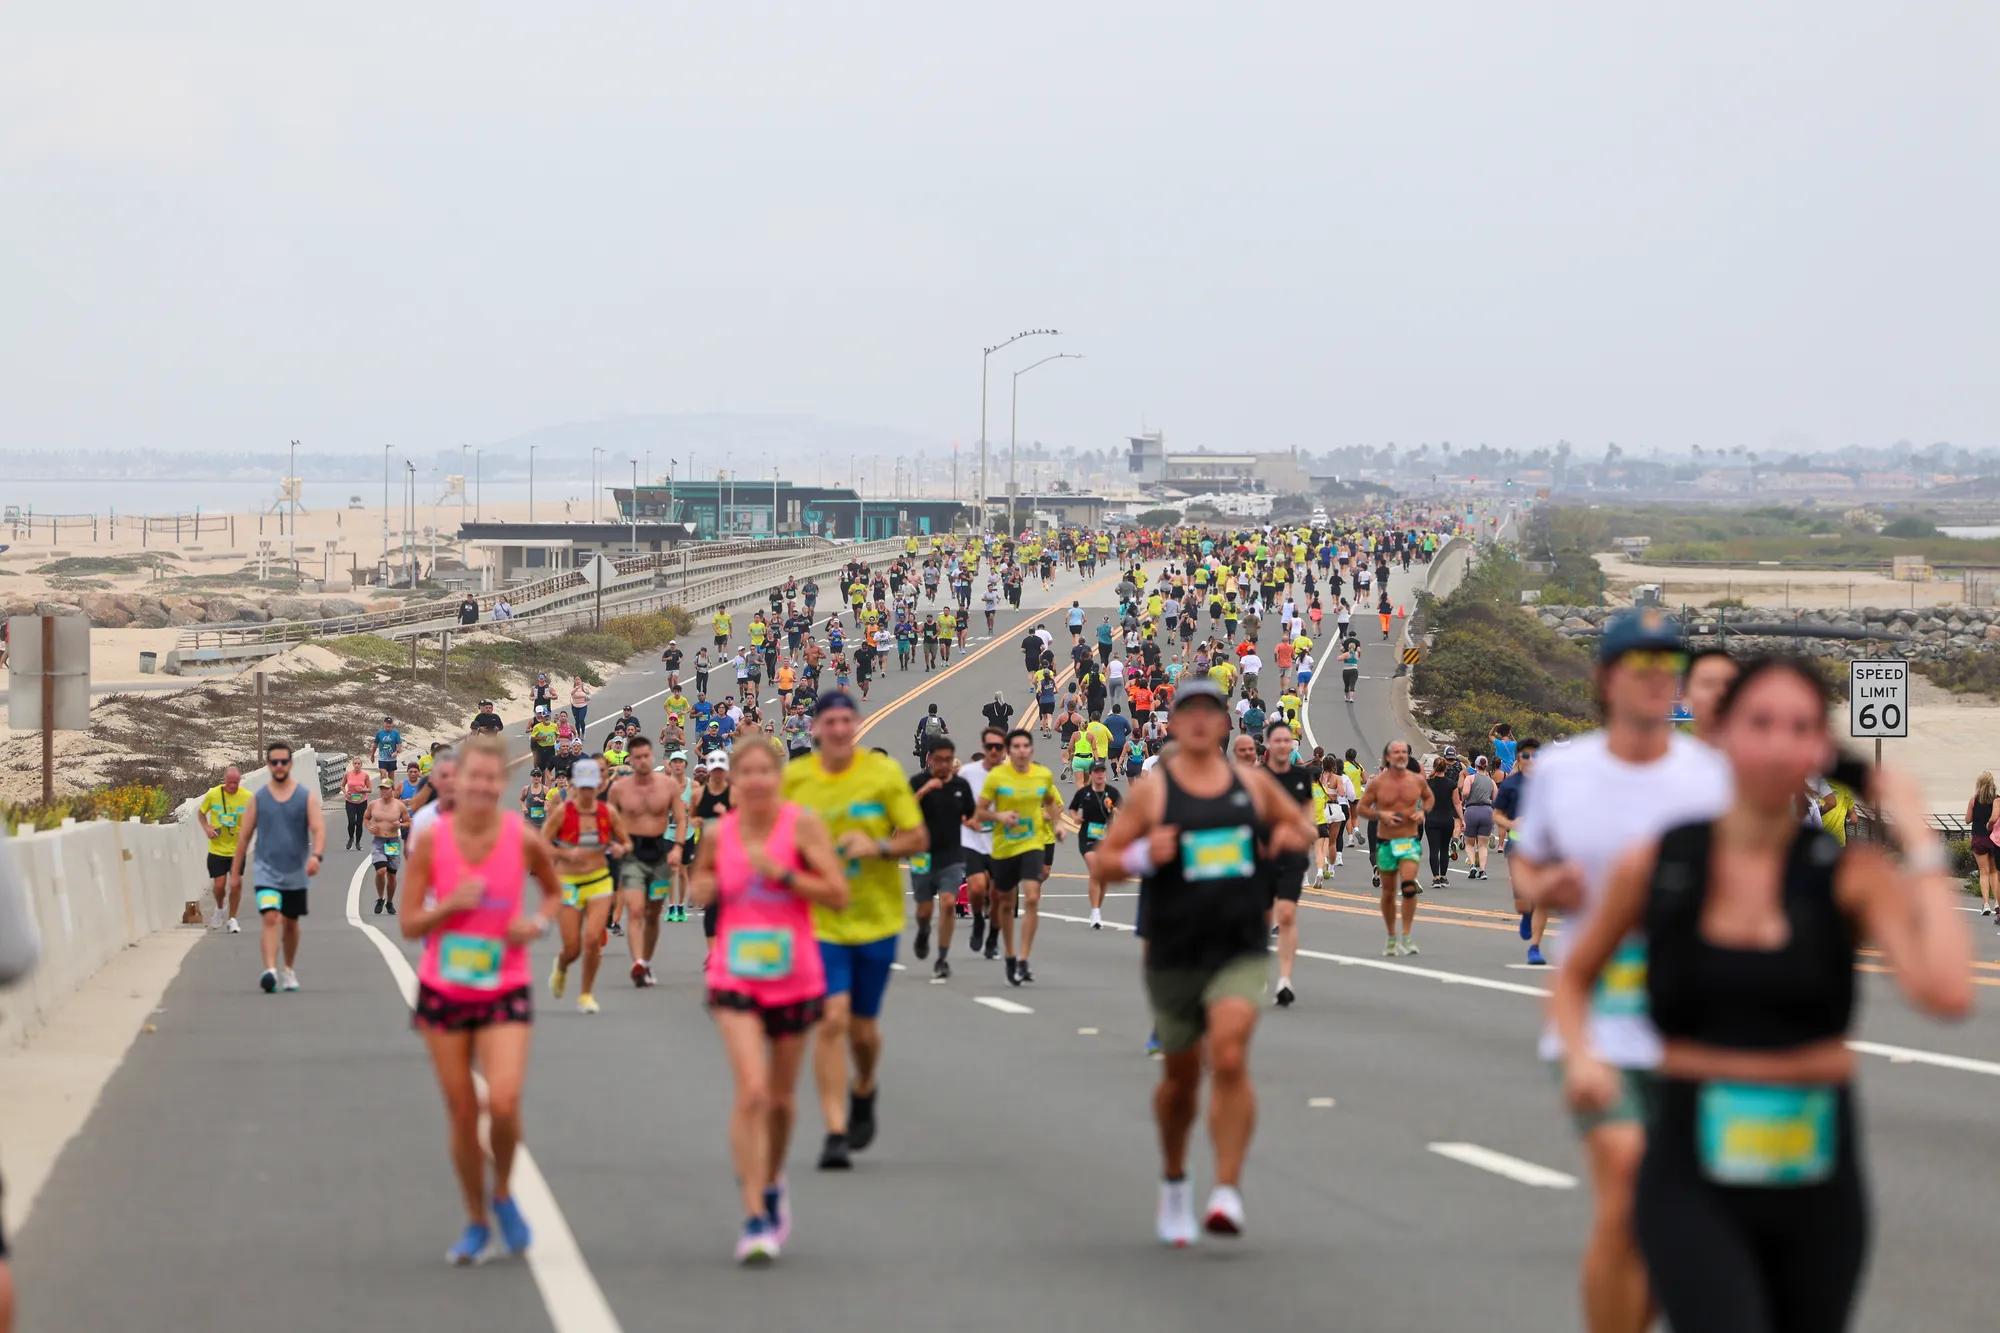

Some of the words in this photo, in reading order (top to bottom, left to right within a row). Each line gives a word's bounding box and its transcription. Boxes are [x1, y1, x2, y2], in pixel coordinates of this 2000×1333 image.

[1856, 669, 1903, 679] SPEED
[1860, 687, 1898, 698] LIMIT
[1859, 704, 1900, 730] 60
